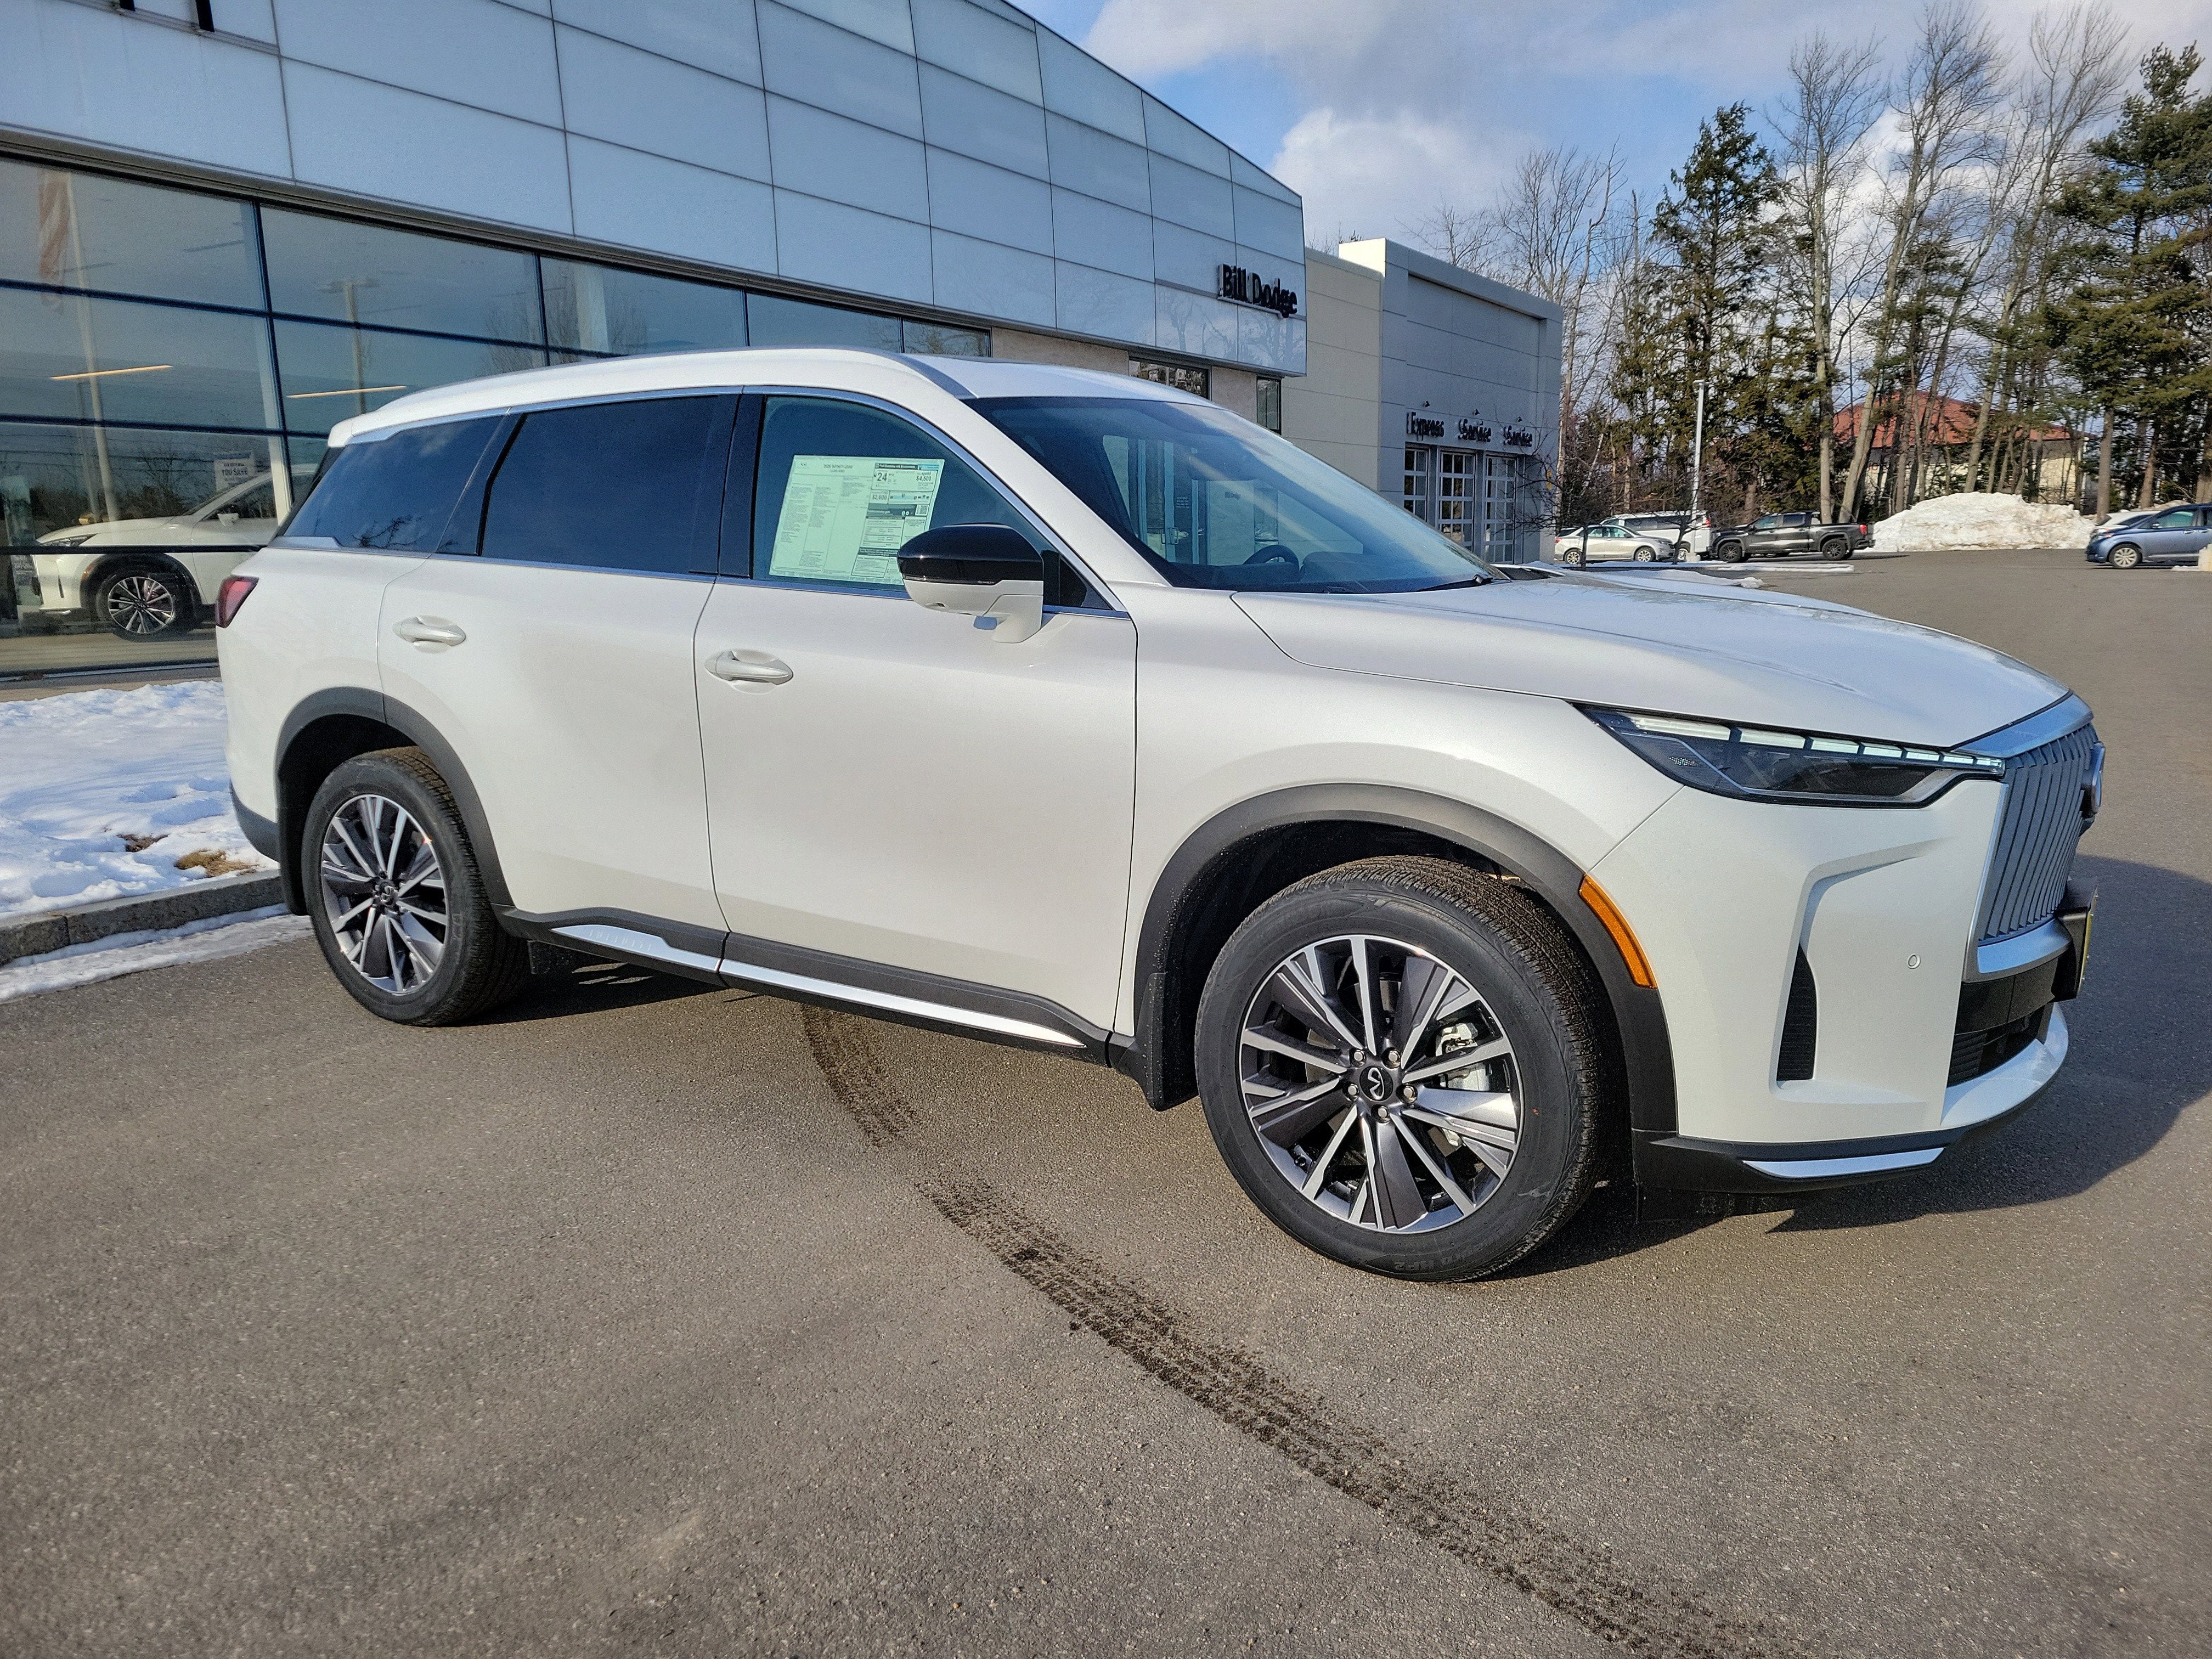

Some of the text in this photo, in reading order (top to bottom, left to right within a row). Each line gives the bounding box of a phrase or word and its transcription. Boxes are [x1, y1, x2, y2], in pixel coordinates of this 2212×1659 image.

[1218, 263, 1297, 318] Bill Dodge
[1406, 411, 1444, 441] Express
[1458, 418, 1492, 443] Service
[1503, 425, 1533, 448] Service
[877, 472, 887, 482] 24
